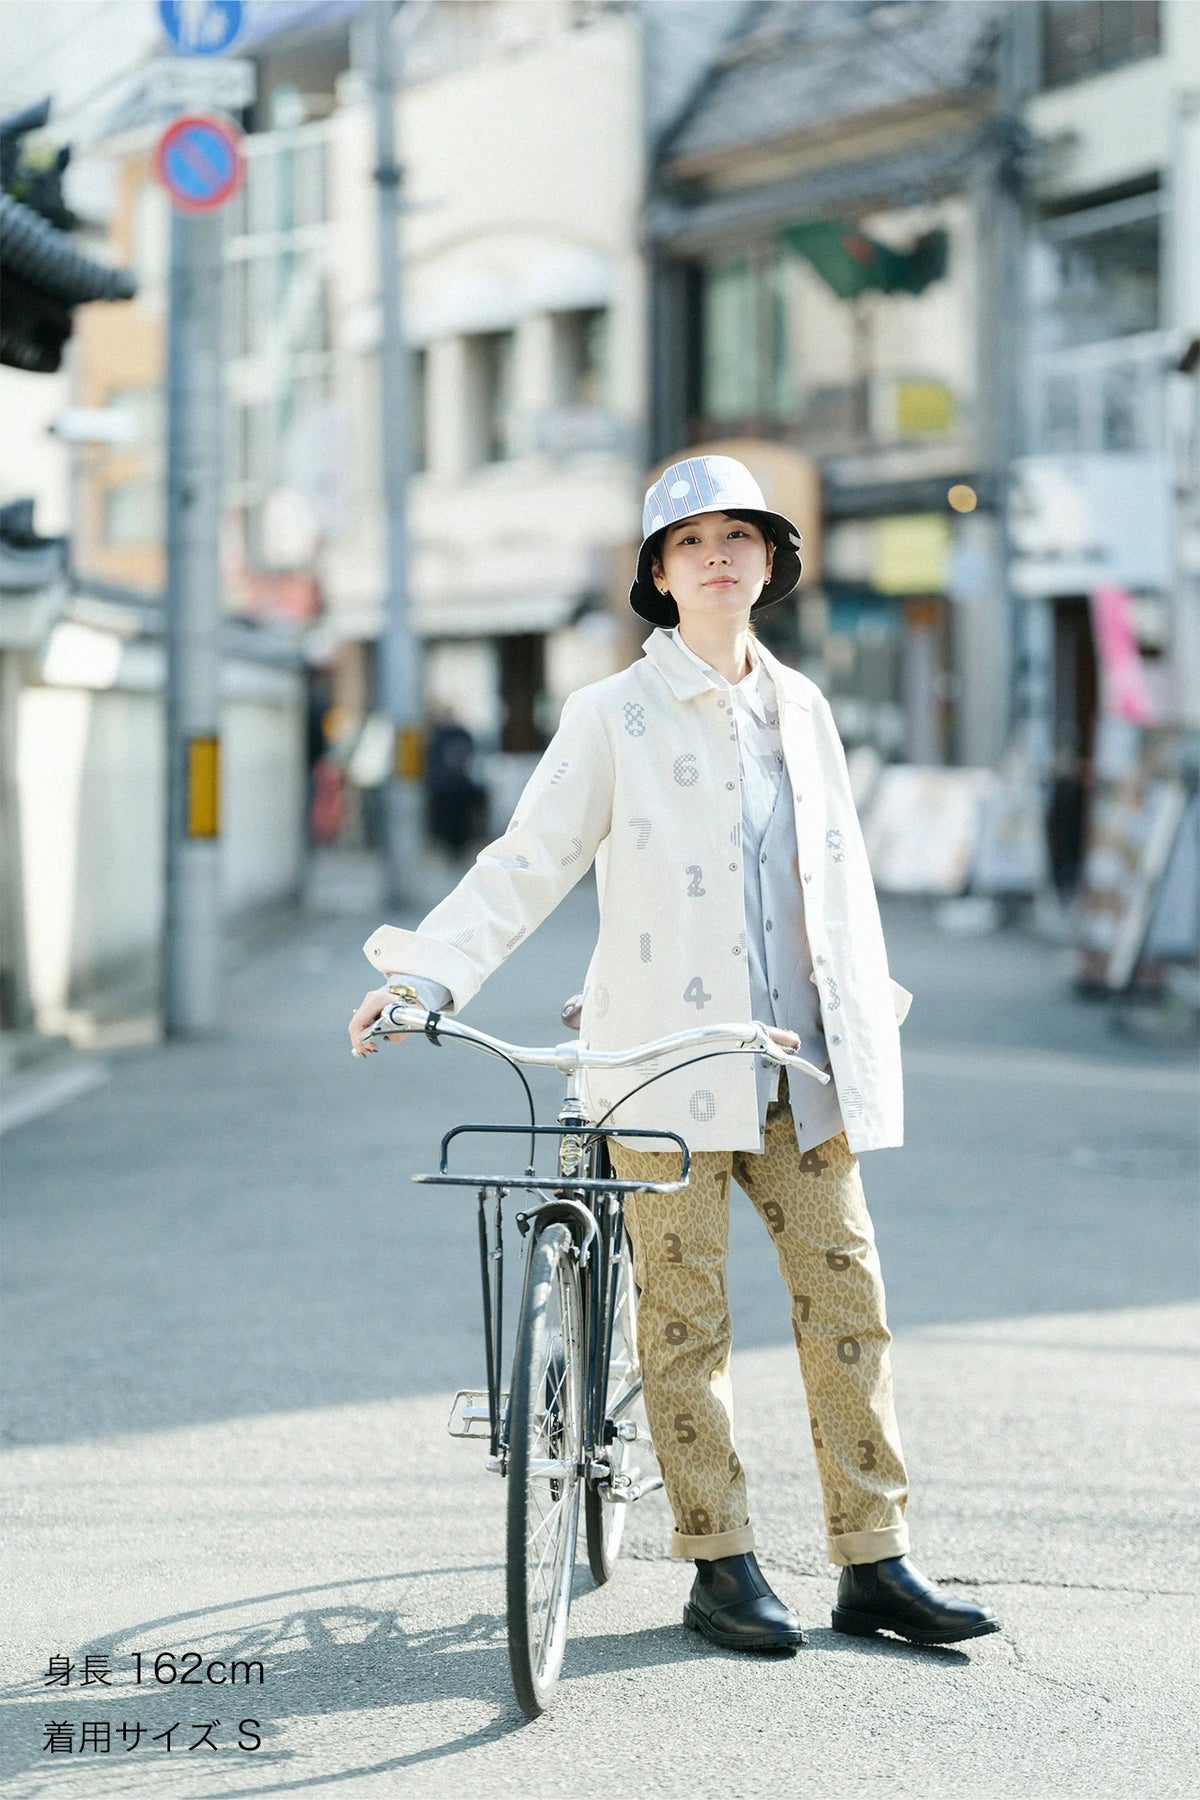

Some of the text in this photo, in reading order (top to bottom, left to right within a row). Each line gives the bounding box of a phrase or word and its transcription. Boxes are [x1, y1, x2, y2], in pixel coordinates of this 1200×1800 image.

[623, 702, 645, 737] 8
[673, 753, 699, 787] 6
[628, 818, 652, 850] 7
[685, 865, 706, 897] 2
[683, 976, 712, 1010] 4
[689, 1089, 717, 1122] 0
[799, 1148, 828, 1177] 4
[763, 1201, 785, 1234] 9
[662, 1232, 683, 1263] 3
[826, 1247, 851, 1272] 6
[794, 1295, 811, 1322] 7
[836, 1335, 861, 1365] 0
[674, 1413, 697, 1444] 5
[857, 1439, 877, 1471] 3
